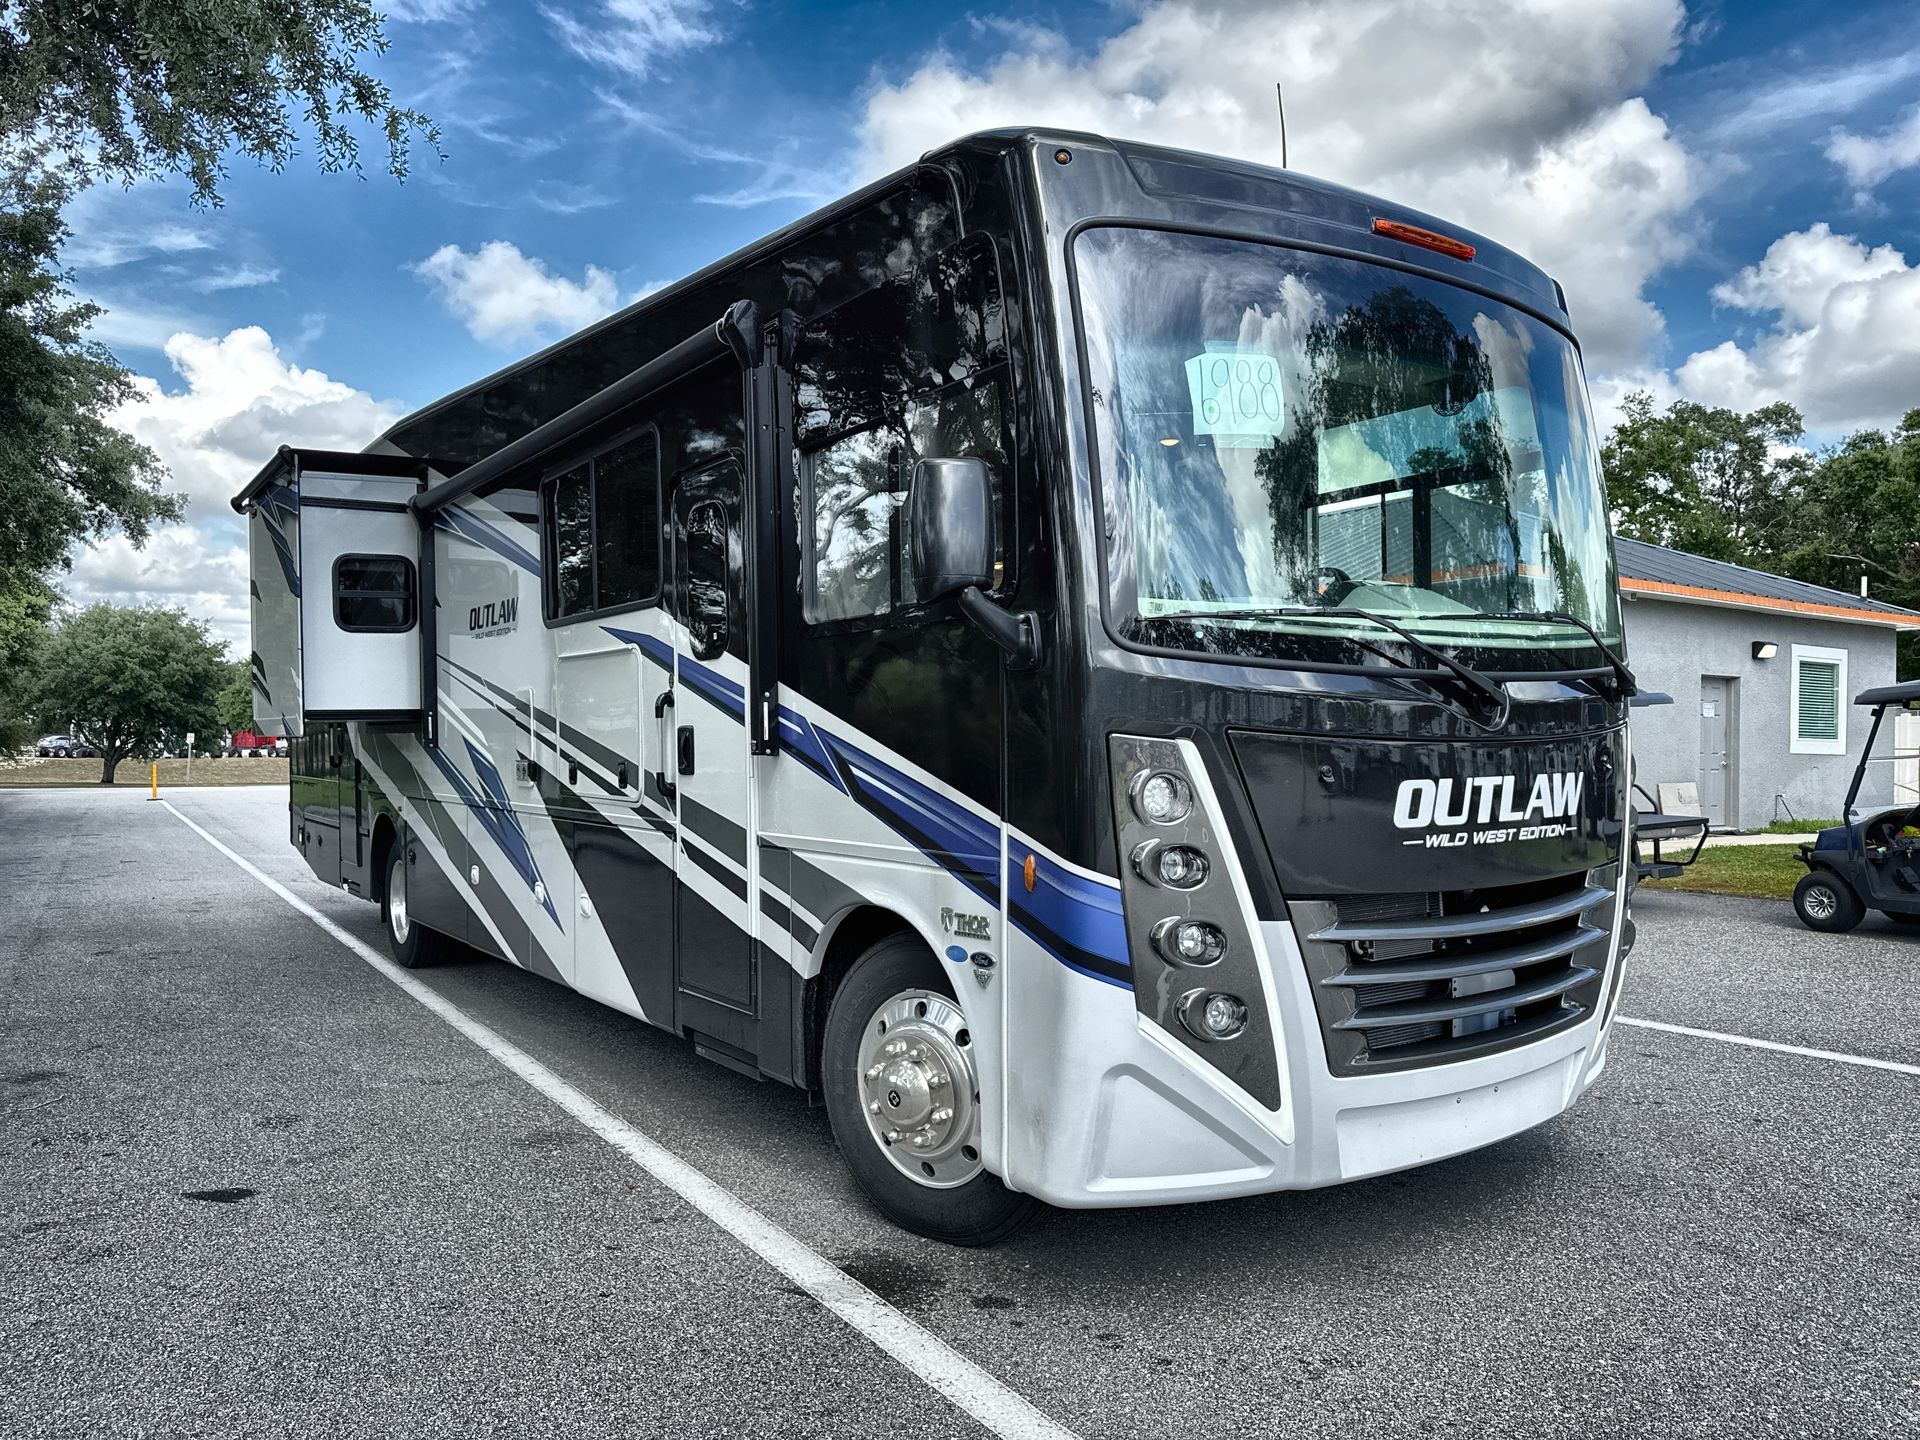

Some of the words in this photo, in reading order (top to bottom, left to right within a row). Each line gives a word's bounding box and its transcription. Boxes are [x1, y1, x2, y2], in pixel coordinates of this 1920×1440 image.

[1199, 358, 1280, 425] 6988
[469, 596, 519, 631] OUTLAW
[1393, 772, 1584, 829] OUTLAW
[1425, 832, 1468, 848] WILD
[1473, 828, 1517, 845] WEST
[1518, 823, 1566, 841] EDITION
[954, 912, 991, 936] THOR
